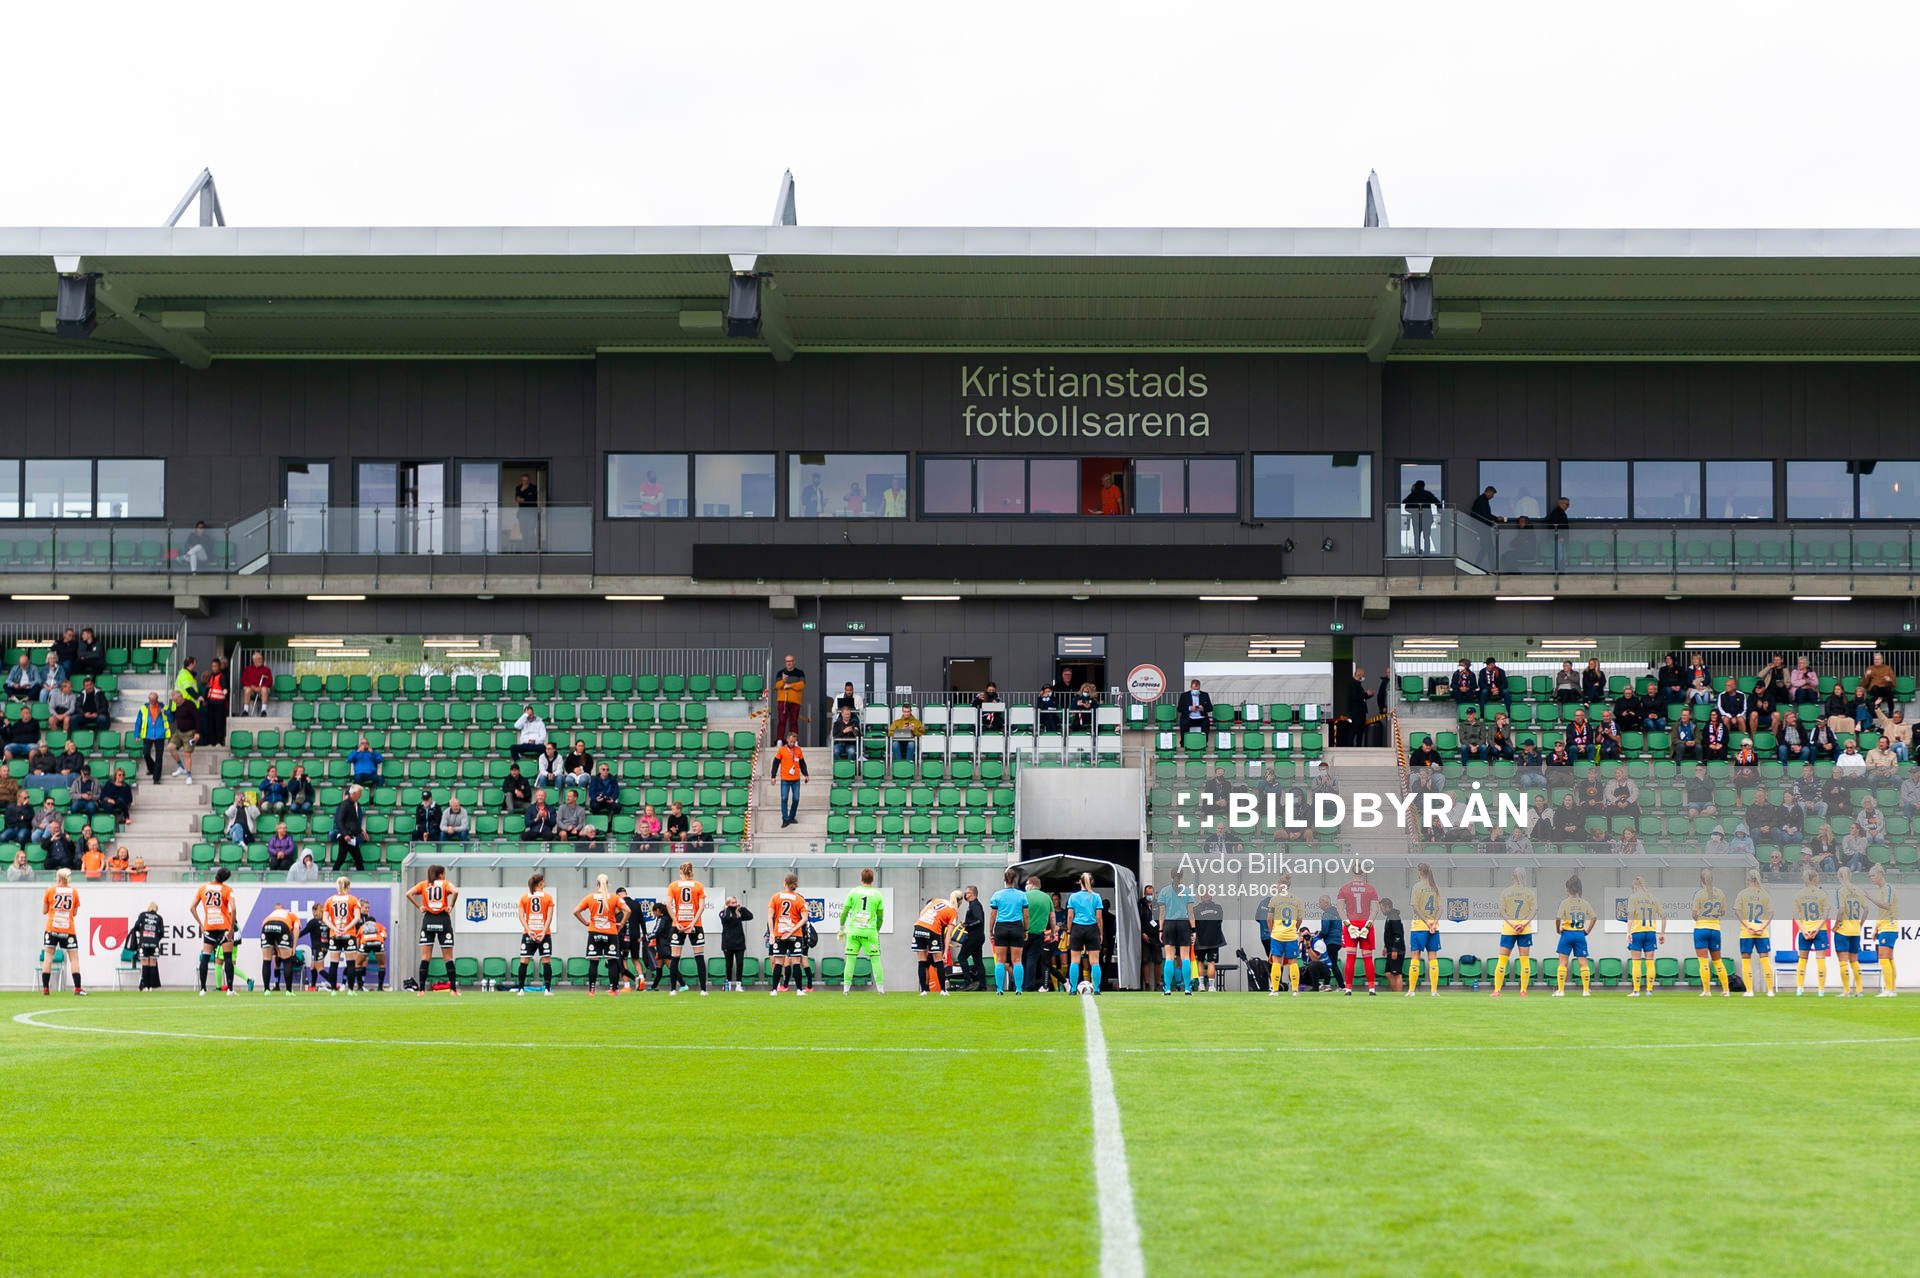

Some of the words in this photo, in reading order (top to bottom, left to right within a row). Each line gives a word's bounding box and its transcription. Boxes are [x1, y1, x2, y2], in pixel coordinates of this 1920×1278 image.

[961, 366, 1209, 397] Kristianstads
[962, 405, 1210, 437] fotbollsarena
[54, 894, 73, 910] 25
[205, 891, 222, 907] 23
[427, 886, 442, 901] 10
[682, 887, 691, 903] 6
[333, 902, 348, 917] 18
[531, 897, 541, 913] 8
[597, 899, 604, 914] 7
[782, 901, 791, 916] 2
[861, 896, 868, 911] 1
[1353, 893, 1362, 914] 1
[1424, 895, 1435, 915] 4
[1472, 901, 1499, 910] Kristia
[1514, 899, 1524, 919] 7
[1801, 902, 1820, 922] 19
[1847, 900, 1860, 920] 13
[1281, 907, 1293, 927] 9
[1640, 907, 1653, 928] 11
[1747, 903, 1764, 924] 12
